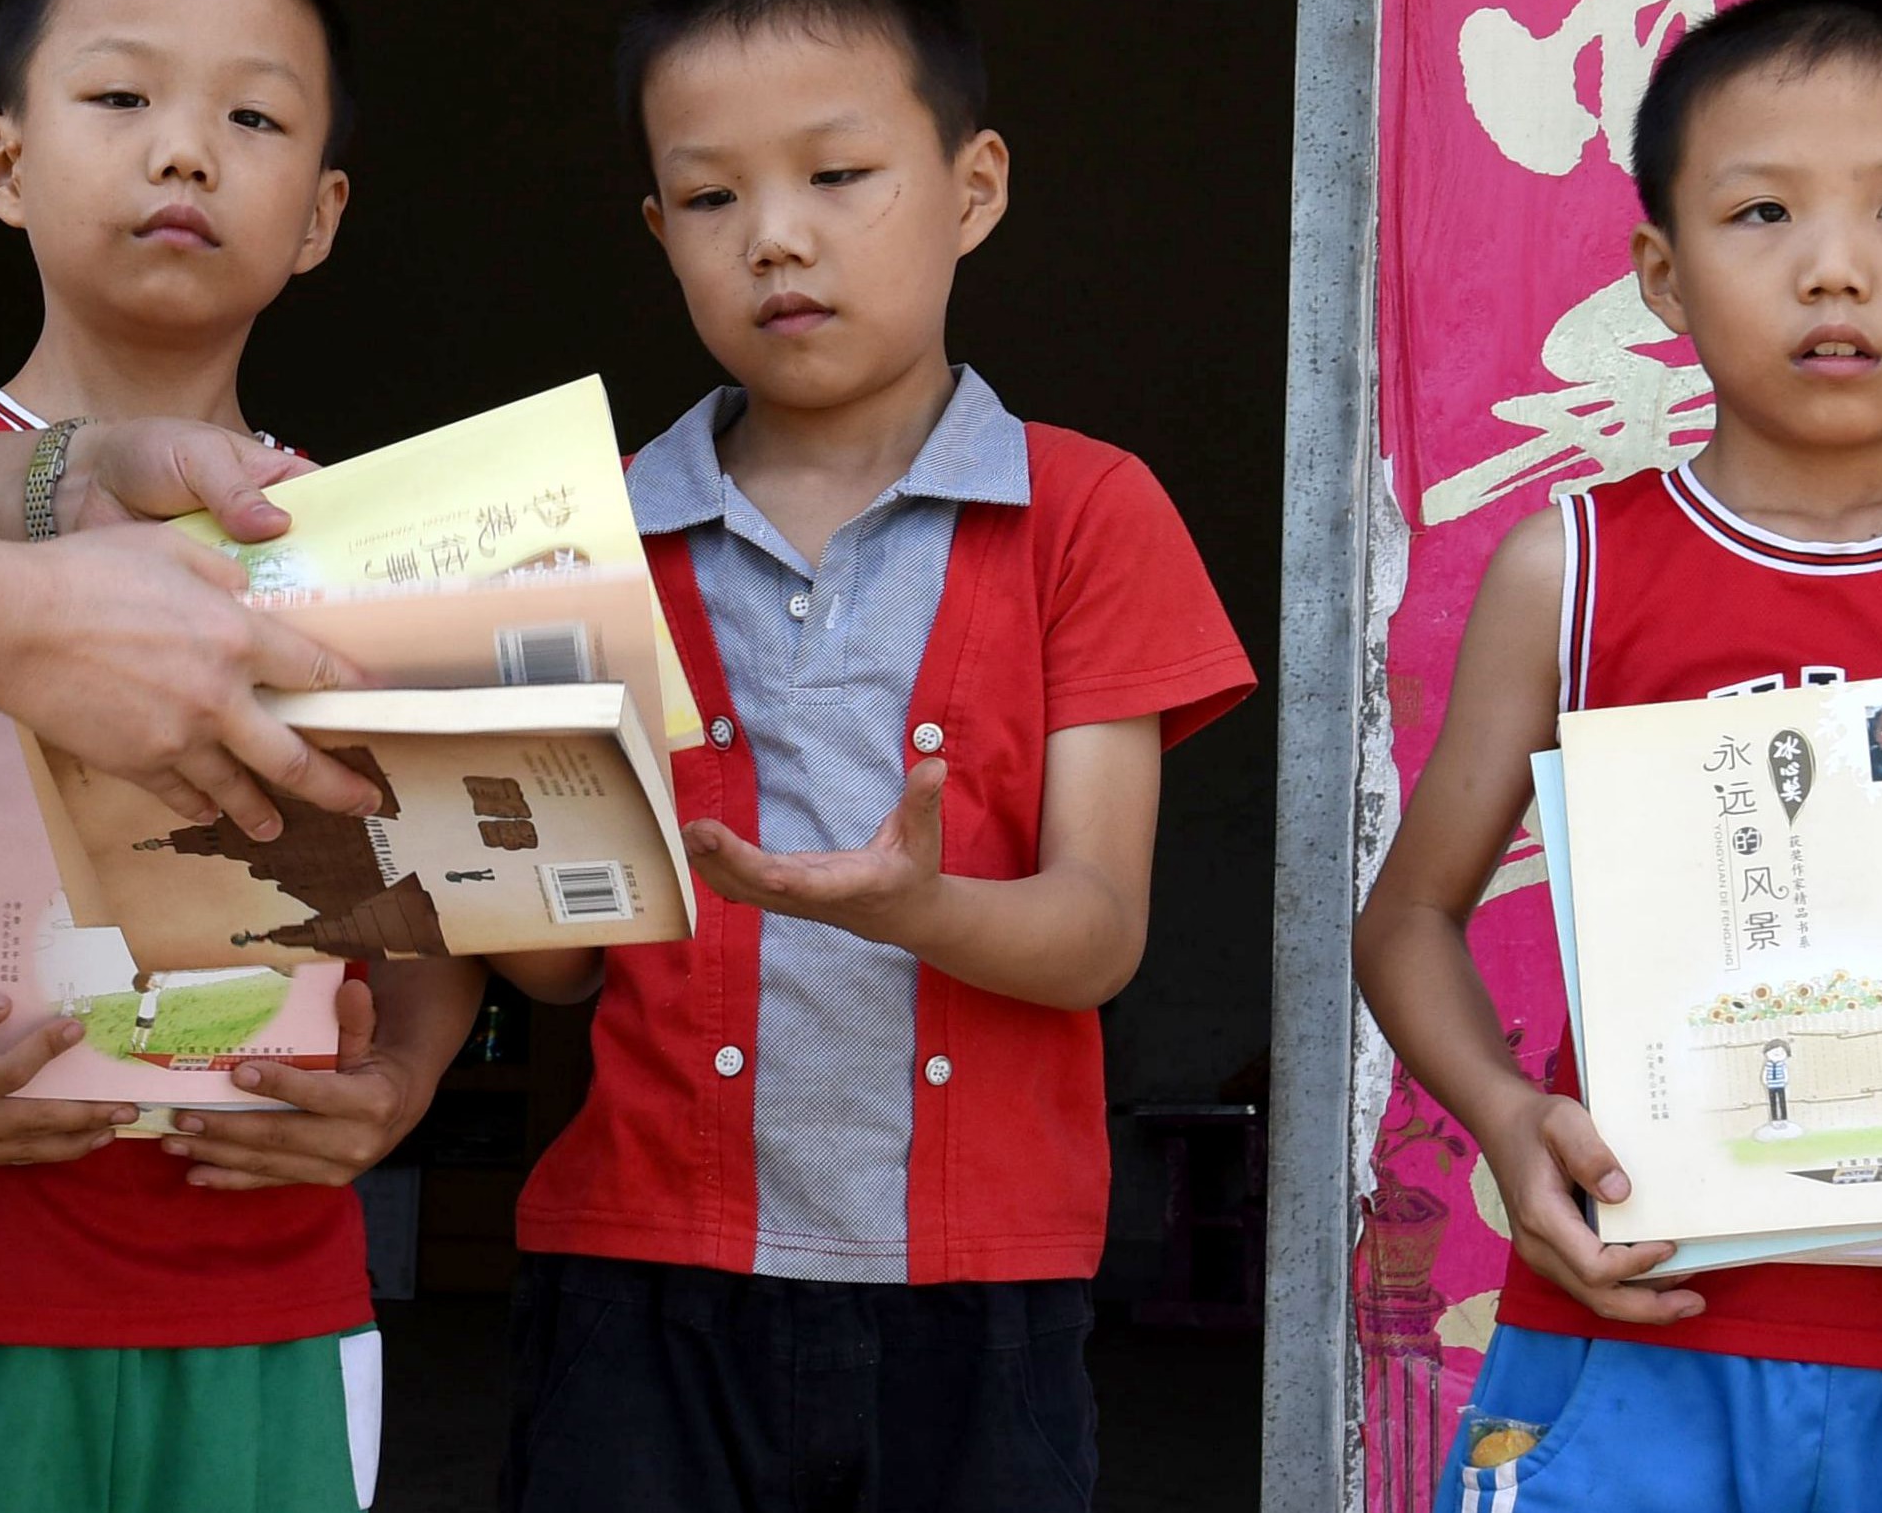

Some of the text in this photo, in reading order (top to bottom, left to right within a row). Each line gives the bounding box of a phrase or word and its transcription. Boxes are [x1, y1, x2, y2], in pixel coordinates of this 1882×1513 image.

[1773, 735, 1803, 803] 冰心奖
[1703, 735, 1790, 951] 永远的风景
[1789, 834, 1810, 949] 获奖作家精品书系
